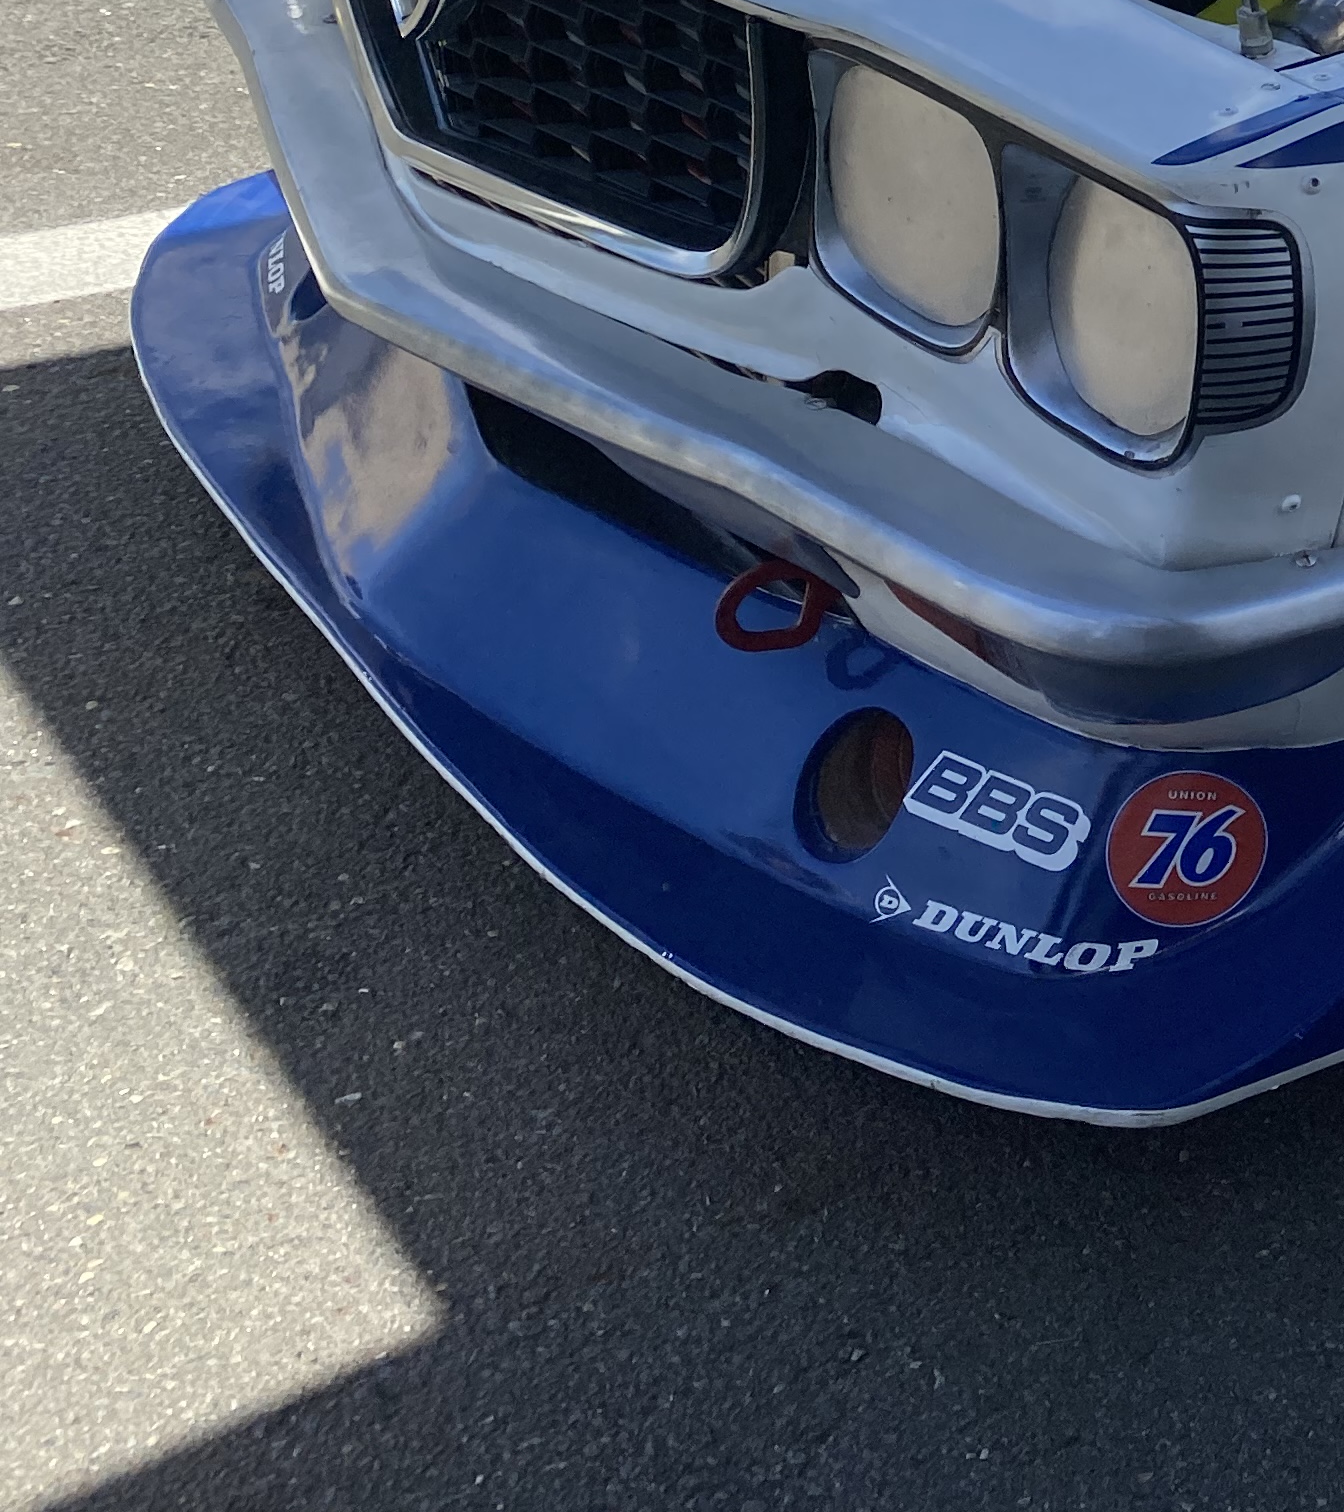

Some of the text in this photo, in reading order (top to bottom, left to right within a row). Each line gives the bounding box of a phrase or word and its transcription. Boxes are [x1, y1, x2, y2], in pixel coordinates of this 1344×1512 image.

[903, 750, 1092, 872] BBS
[1167, 788, 1218, 802] UNION
[1128, 803, 1246, 889] 76
[1147, 890, 1219, 902] GASOLINE
[912, 899, 1160, 973] DUNLOP
